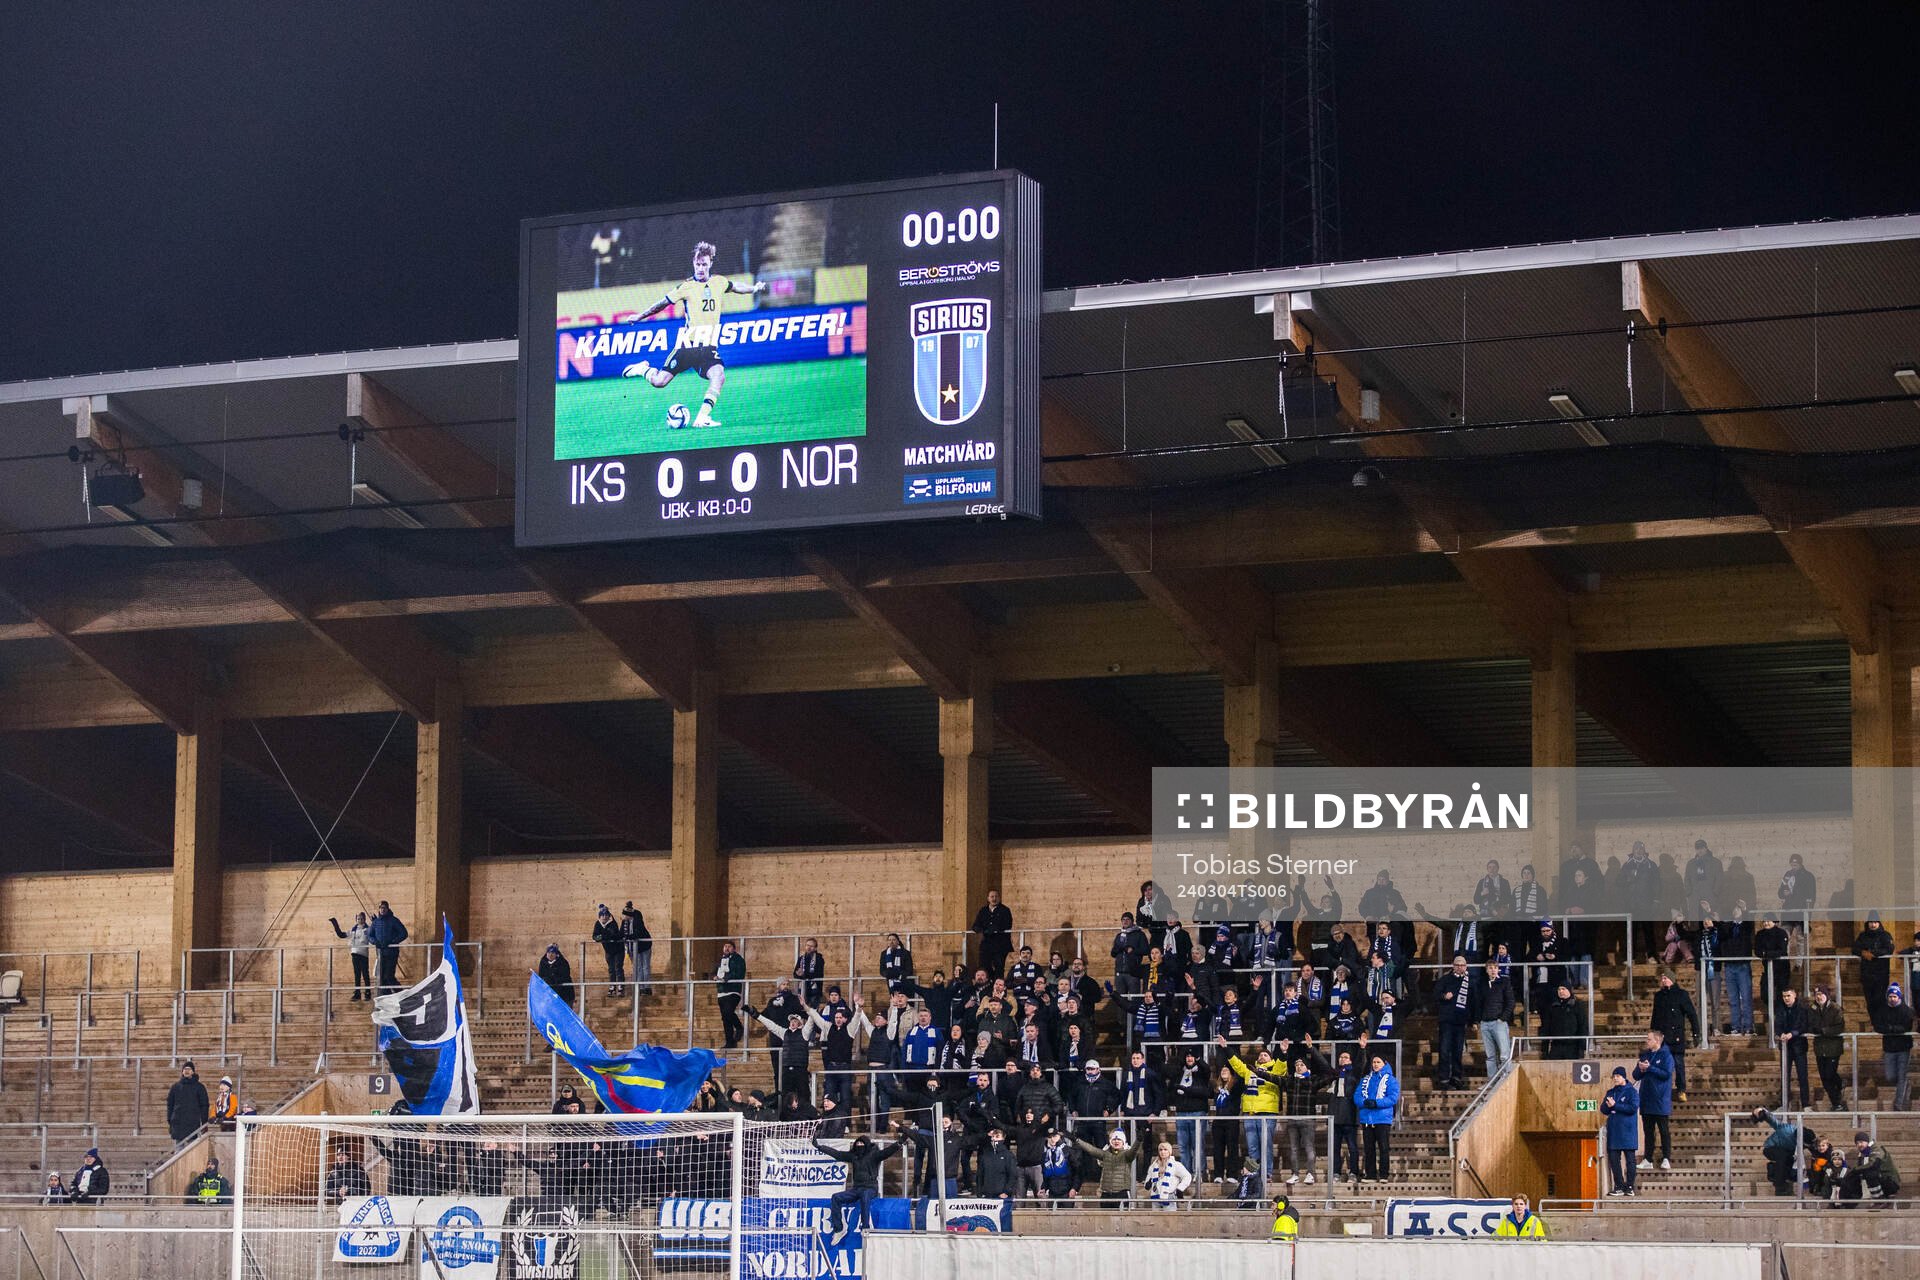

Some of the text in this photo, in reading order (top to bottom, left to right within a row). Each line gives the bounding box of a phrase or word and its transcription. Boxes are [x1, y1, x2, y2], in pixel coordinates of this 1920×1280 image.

[903, 205, 1000, 248] 00:00
[702, 299, 716, 313] 20
[918, 304, 984, 333] SIRIUS
[574, 312, 848, 359] KÄMPA KRISTOFFER!
[966, 335, 980, 349] 07
[921, 339, 935, 352] 19
[904, 440, 996, 466] MATCHVÄRD
[571, 461, 626, 505] IKS
[657, 457, 684, 498] 0
[731, 452, 758, 493] 0
[782, 443, 858, 489] NOR
[935, 477, 965, 485] UPPLANDS
[935, 481, 992, 496] BILFORUM
[965, 503, 1006, 515] LEDtec
[1580, 1063, 1593, 1083] 8
[375, 1076, 385, 1093] 9
[358, 1246, 378, 1256] 2022
